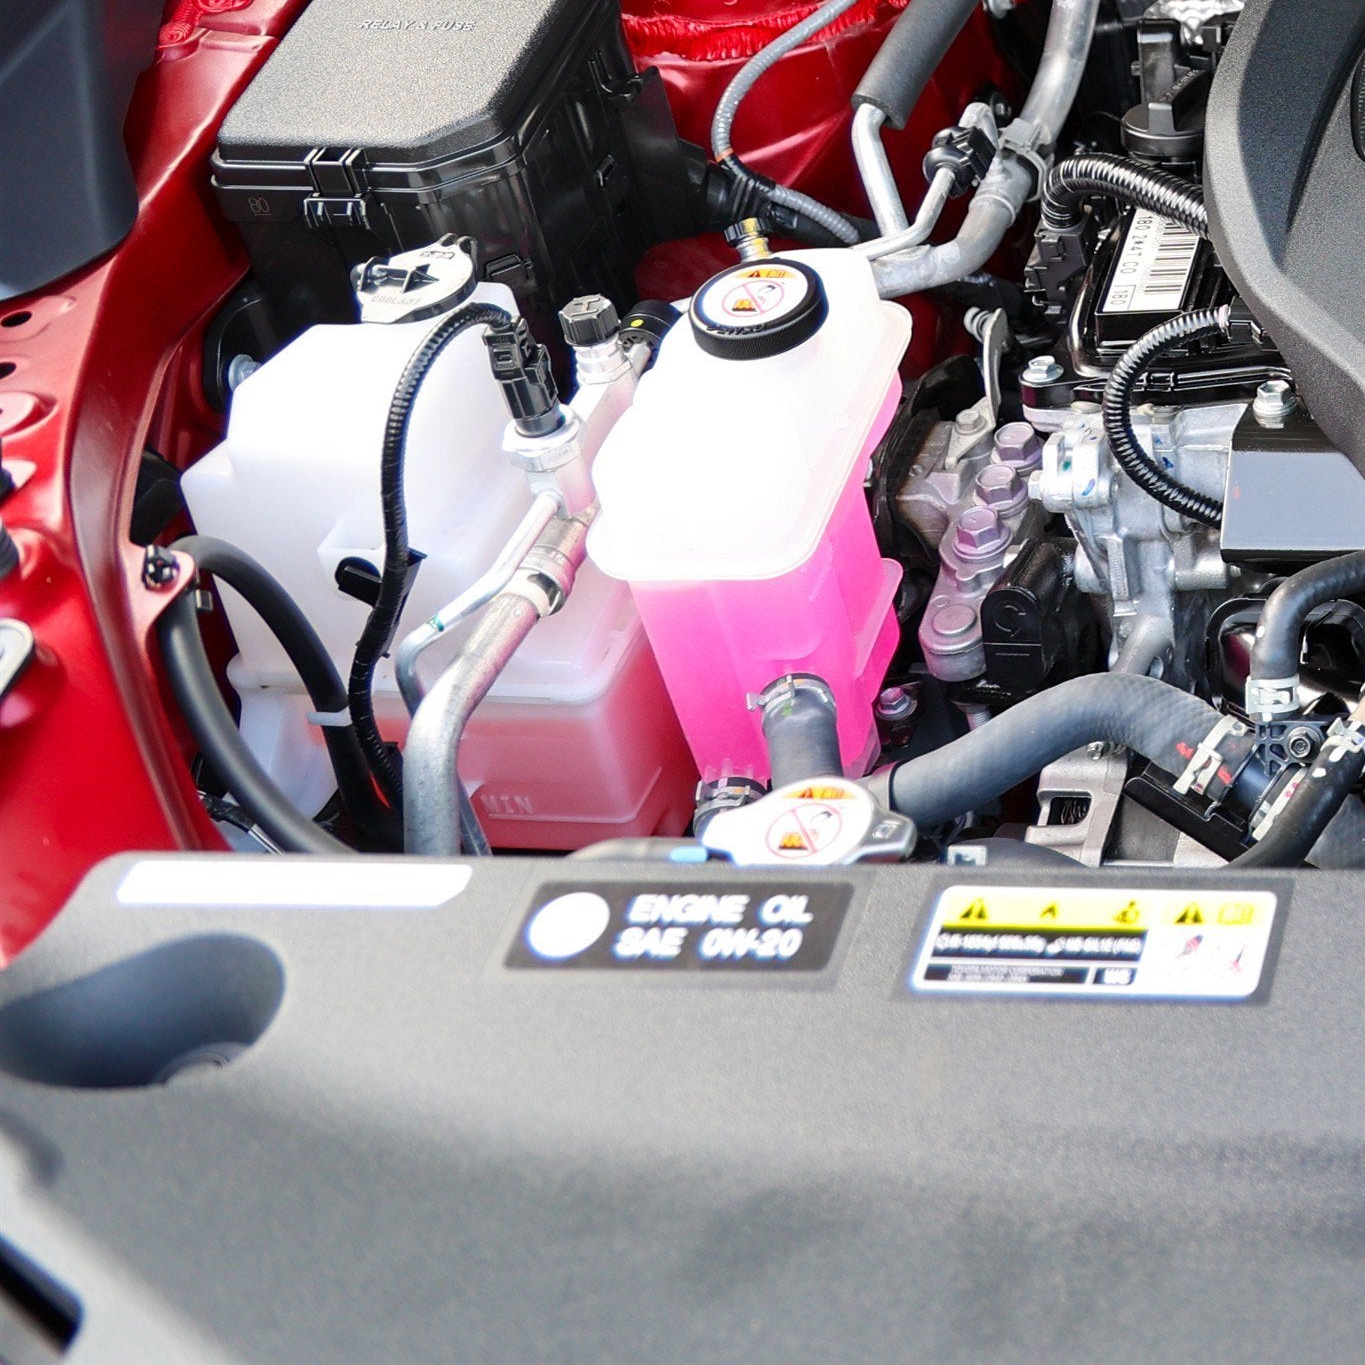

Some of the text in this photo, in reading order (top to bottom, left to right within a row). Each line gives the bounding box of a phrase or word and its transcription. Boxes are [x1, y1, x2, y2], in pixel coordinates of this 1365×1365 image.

[361, 19, 416, 31] RELAY
[433, 21, 476, 32] FUSE
[1135, 215, 1154, 231] 180
[371, 295, 422, 306] COOLANT
[1110, 289, 1129, 306] 180
[480, 795, 533, 814] MIN
[627, 894, 814, 925] ENGINE OIL
[613, 926, 804, 960] SAE 0W-20
